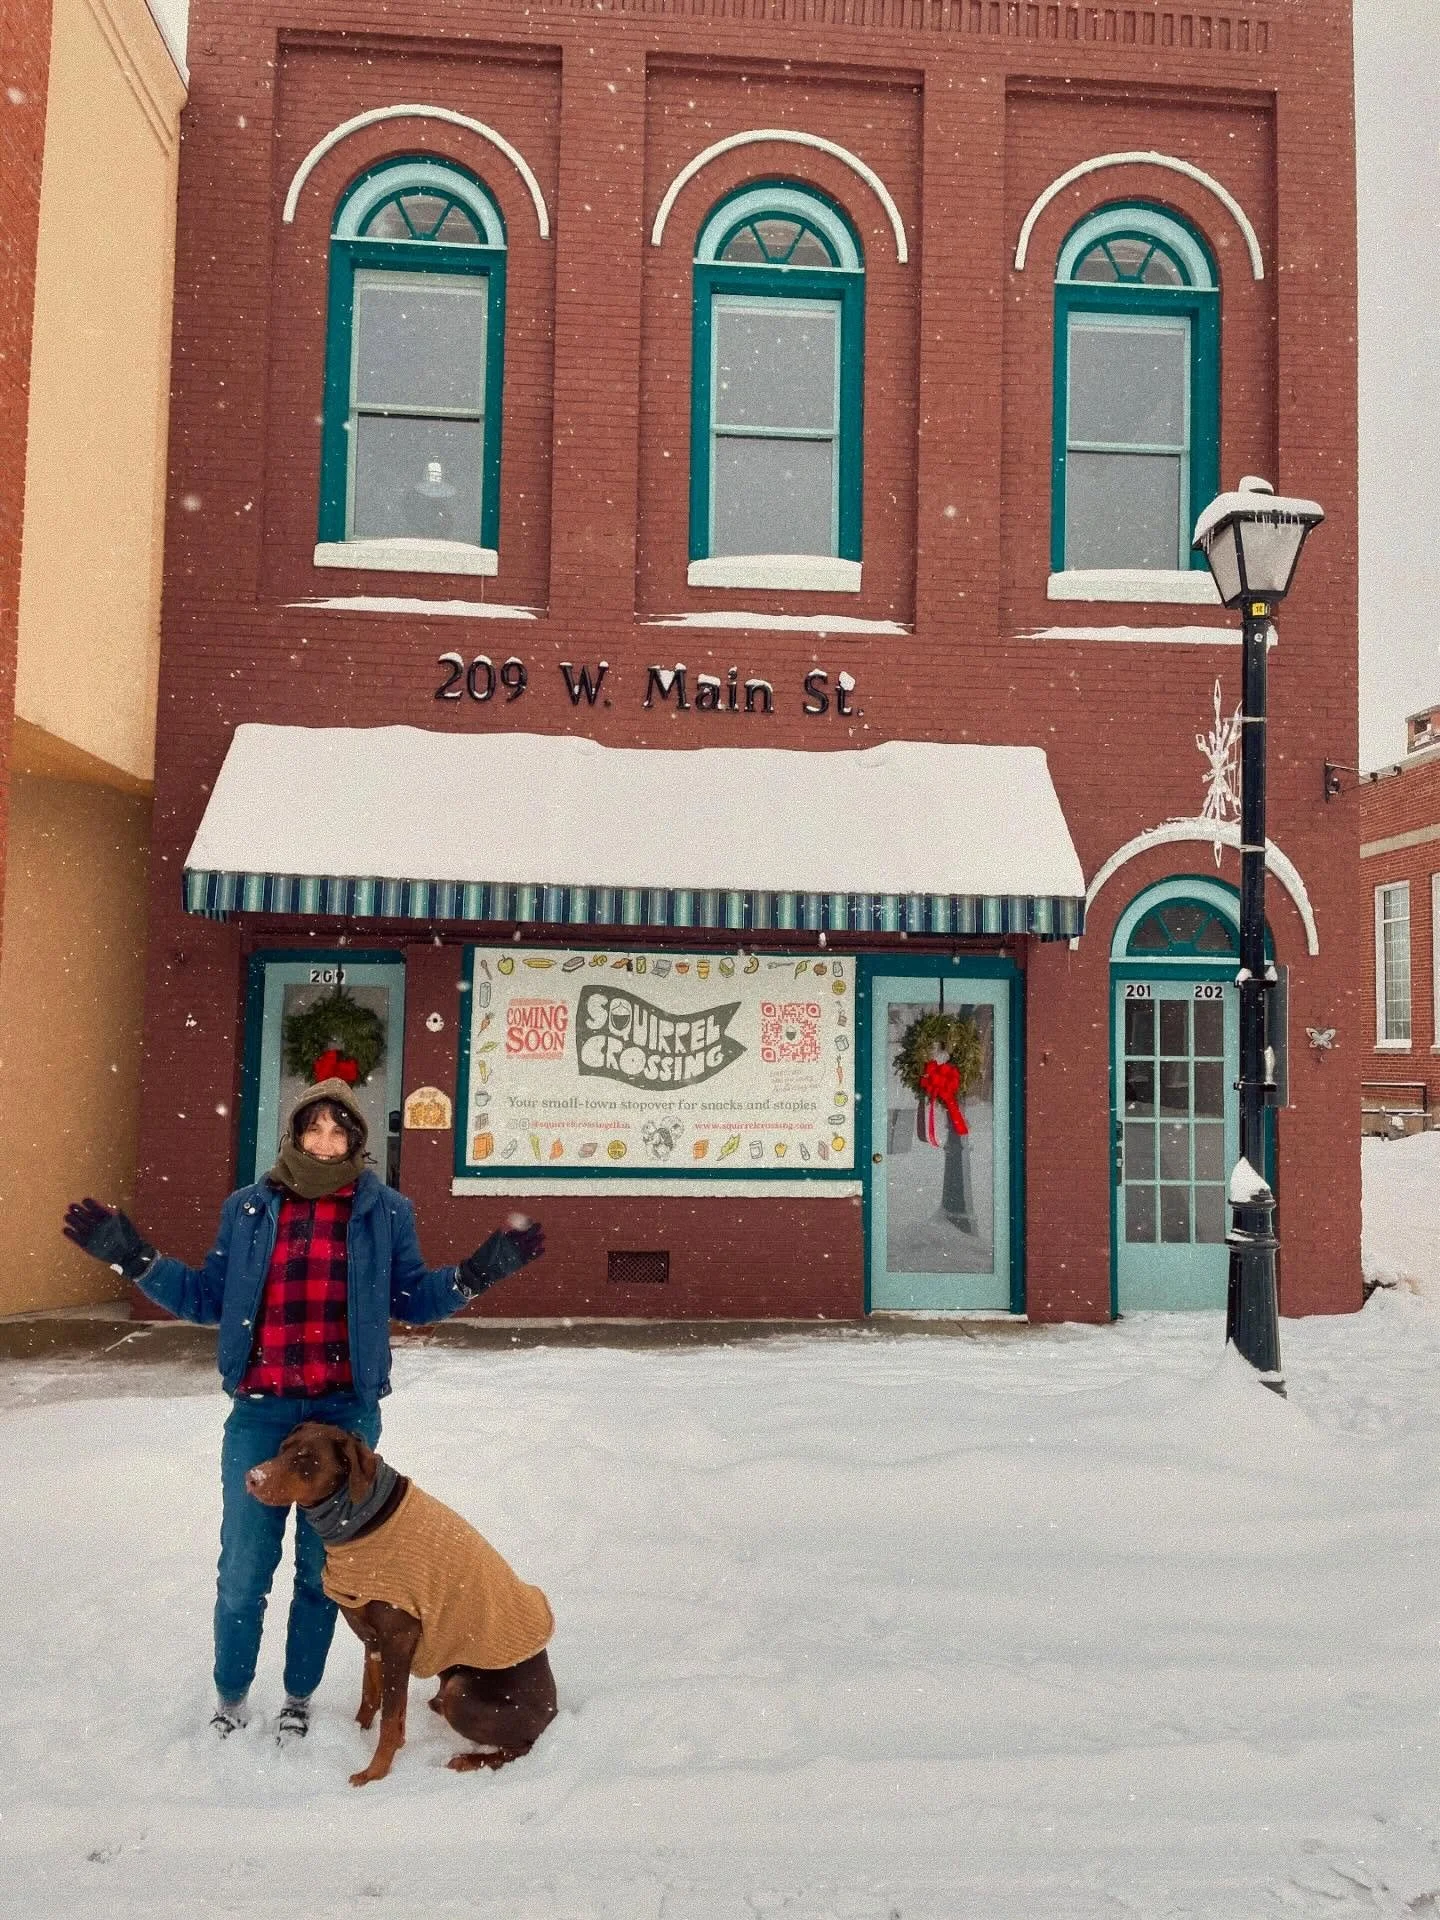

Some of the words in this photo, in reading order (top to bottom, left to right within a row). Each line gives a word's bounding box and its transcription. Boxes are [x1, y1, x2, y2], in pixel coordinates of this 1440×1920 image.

[434, 654, 529, 701] 209
[560, 662, 612, 707] W.
[642, 664, 775, 714] Main
[802, 670, 866, 717] St.
[311, 970, 344, 983] 209
[1126, 984, 1151, 998] 201
[1194, 985, 1223, 999] 202
[507, 1005, 569, 1032] COMING
[585, 993, 720, 1054] SQUIRREL
[506, 1027, 566, 1053] SOON
[581, 1035, 724, 1081] CROSSING
[508, 1096, 536, 1108] Your
[541, 1097, 617, 1109] small-town
[621, 1100, 675, 1111] stopover
[678, 1100, 697, 1110] for
[701, 1100, 743, 1110] snacks
[746, 1100, 770, 1110] and
[773, 1100, 817, 1112] staples
